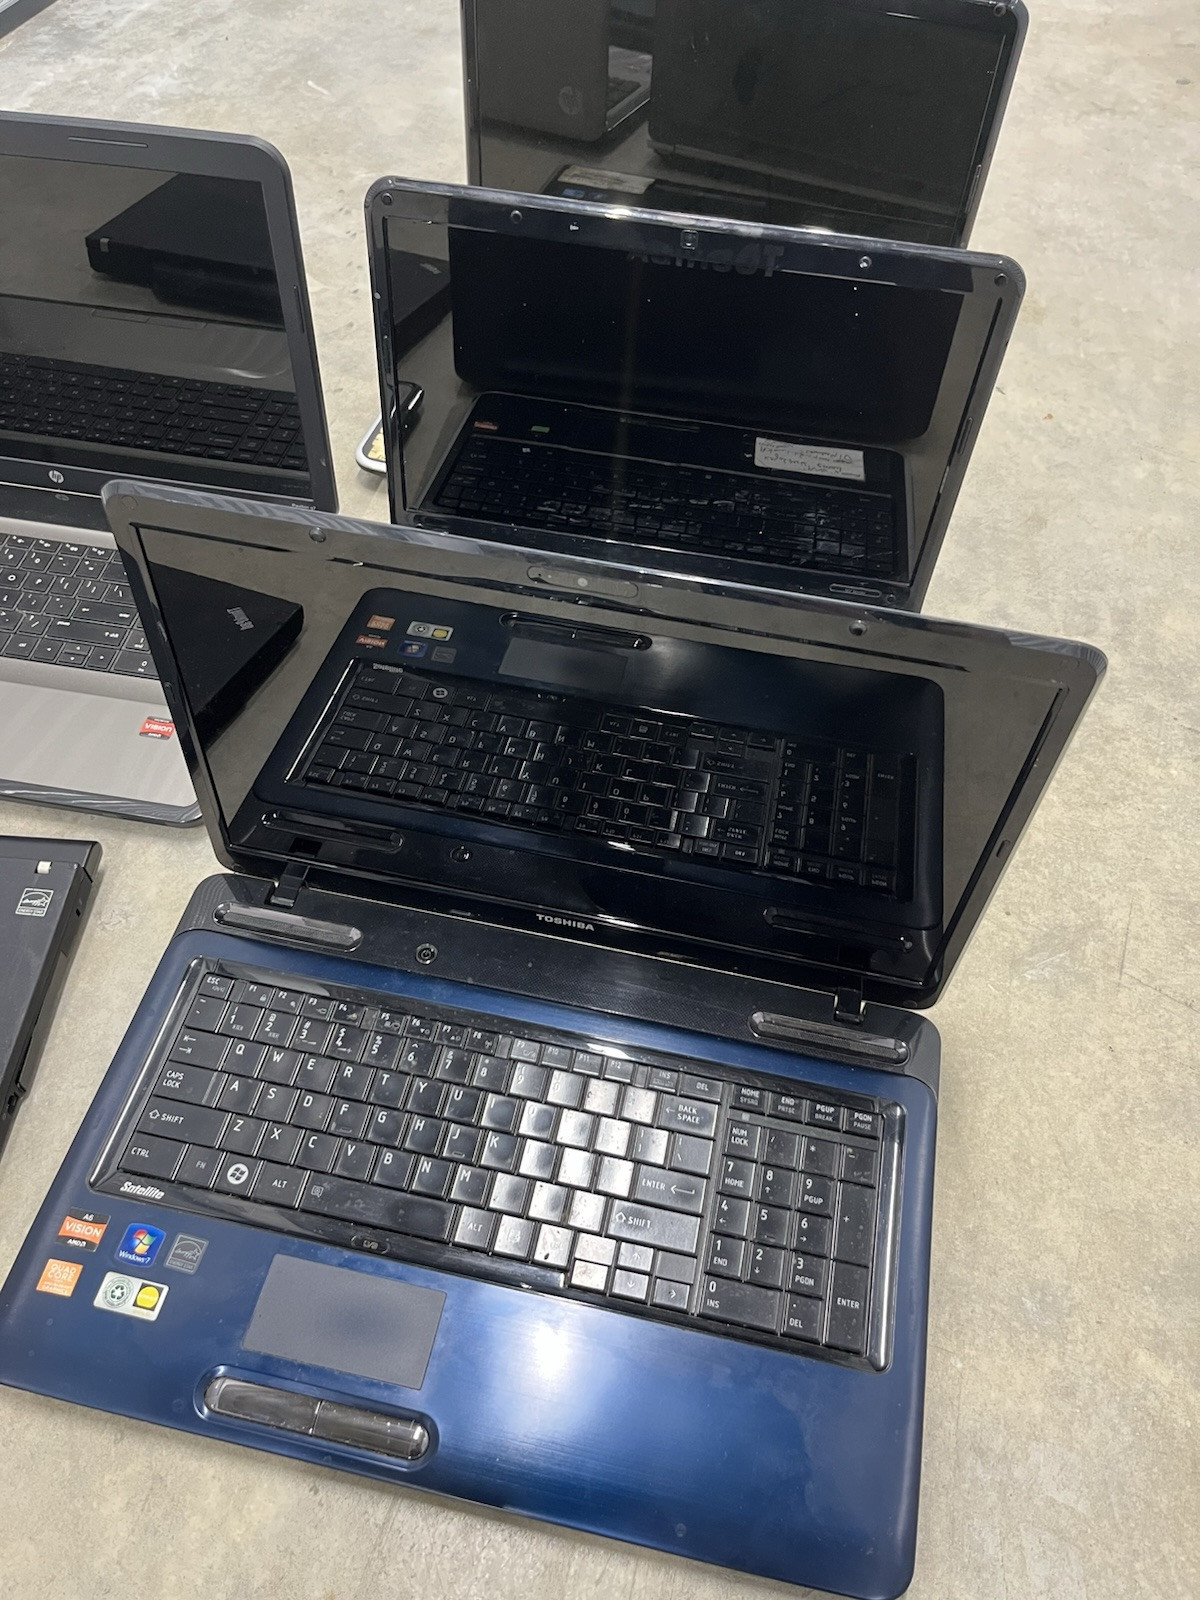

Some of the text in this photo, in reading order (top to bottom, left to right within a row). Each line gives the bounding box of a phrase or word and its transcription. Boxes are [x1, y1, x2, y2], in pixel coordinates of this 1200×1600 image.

[536, 913, 594, 931] TOSHIBA
[207, 977, 220, 985] ESC
[249, 985, 257, 993] F1
[279, 991, 287, 999] F2
[338, 1003, 347, 1011] F4
[230, 1014, 236, 1024] 1
[411, 1018, 420, 1026] F6
[265, 1021, 273, 1031] 2
[304, 1021, 312, 1030] #
[442, 1025, 452, 1033] F7
[300, 1029, 307, 1039] 3
[339, 1028, 346, 1038] $
[473, 1031, 482, 1039] F8
[335, 1038, 343, 1047] 4
[375, 1035, 383, 1045] %
[236, 1043, 246, 1055] Q
[371, 1044, 380, 1055] 5
[272, 1051, 284, 1063] W
[407, 1052, 415, 1062] 6
[579, 1053, 590, 1062] F11
[307, 1059, 316, 1070] E
[445, 1060, 452, 1070] 7
[610, 1061, 622, 1069] F12
[166, 1070, 184, 1080] CAPS
[343, 1066, 353, 1078] R
[480, 1067, 487, 1077] 8
[659, 1070, 671, 1079] INS
[163, 1079, 181, 1089] LOCK
[381, 1073, 390, 1085] T
[517, 1075, 525, 1085] 9
[230, 1080, 239, 1091] A
[418, 1081, 428, 1093] Y
[696, 1081, 709, 1091] DEL
[267, 1088, 277, 1099] S
[454, 1090, 464, 1100] U
[741, 1087, 760, 1098] HOME
[303, 1096, 313, 1108] D
[781, 1096, 795, 1106] END
[339, 1104, 349, 1115] F
[678, 1104, 698, 1114] BACK
[816, 1104, 835, 1114] PGUP
[160, 1112, 184, 1125] SHIFT
[377, 1111, 387, 1124] G
[677, 1113, 700, 1124] SPACE
[815, 1113, 833, 1122] BREAK
[854, 1112, 873, 1122] PGDN
[233, 1119, 244, 1132] Z
[415, 1119, 426, 1131] H
[853, 1121, 872, 1130] PAUSE
[270, 1128, 283, 1140] X
[452, 1128, 461, 1140] J
[732, 1127, 748, 1137] NUM
[308, 1136, 318, 1148] C
[489, 1136, 499, 1149] K
[731, 1136, 749, 1147] LOCK
[131, 1146, 150, 1158] CTRL
[347, 1144, 356, 1156] V
[384, 1152, 393, 1164] B
[195, 1160, 207, 1169] FN
[421, 1161, 432, 1173] N
[727, 1161, 734, 1172] 7
[460, 1169, 472, 1182] M
[766, 1170, 773, 1181] 8
[272, 1179, 288, 1189] ALT
[642, 1179, 666, 1191] ENTER
[724, 1177, 744, 1188] HOME
[806, 1179, 813, 1189] 9
[120, 1181, 165, 1200] Satellite
[804, 1195, 824, 1205] PGUP
[720, 1200, 729, 1212] 4
[83, 1213, 94, 1221] A6
[760, 1209, 768, 1220] 5
[467, 1222, 483, 1232] ALT
[628, 1216, 651, 1229] SHIFT
[801, 1218, 808, 1229] 6
[65, 1221, 102, 1236] VISION
[716, 1239, 722, 1251] 1
[118, 1249, 151, 1264] Windows 7
[755, 1249, 763, 1260] 2
[713, 1256, 728, 1267] END
[797, 1257, 804, 1269] 3
[51, 1263, 76, 1274] QUAD
[48, 1271, 73, 1282] CORE
[795, 1275, 815, 1286] PGDN
[709, 1281, 717, 1292] 0
[706, 1298, 720, 1308] INS
[837, 1297, 860, 1309] ENTER
[789, 1317, 803, 1328] DEL
